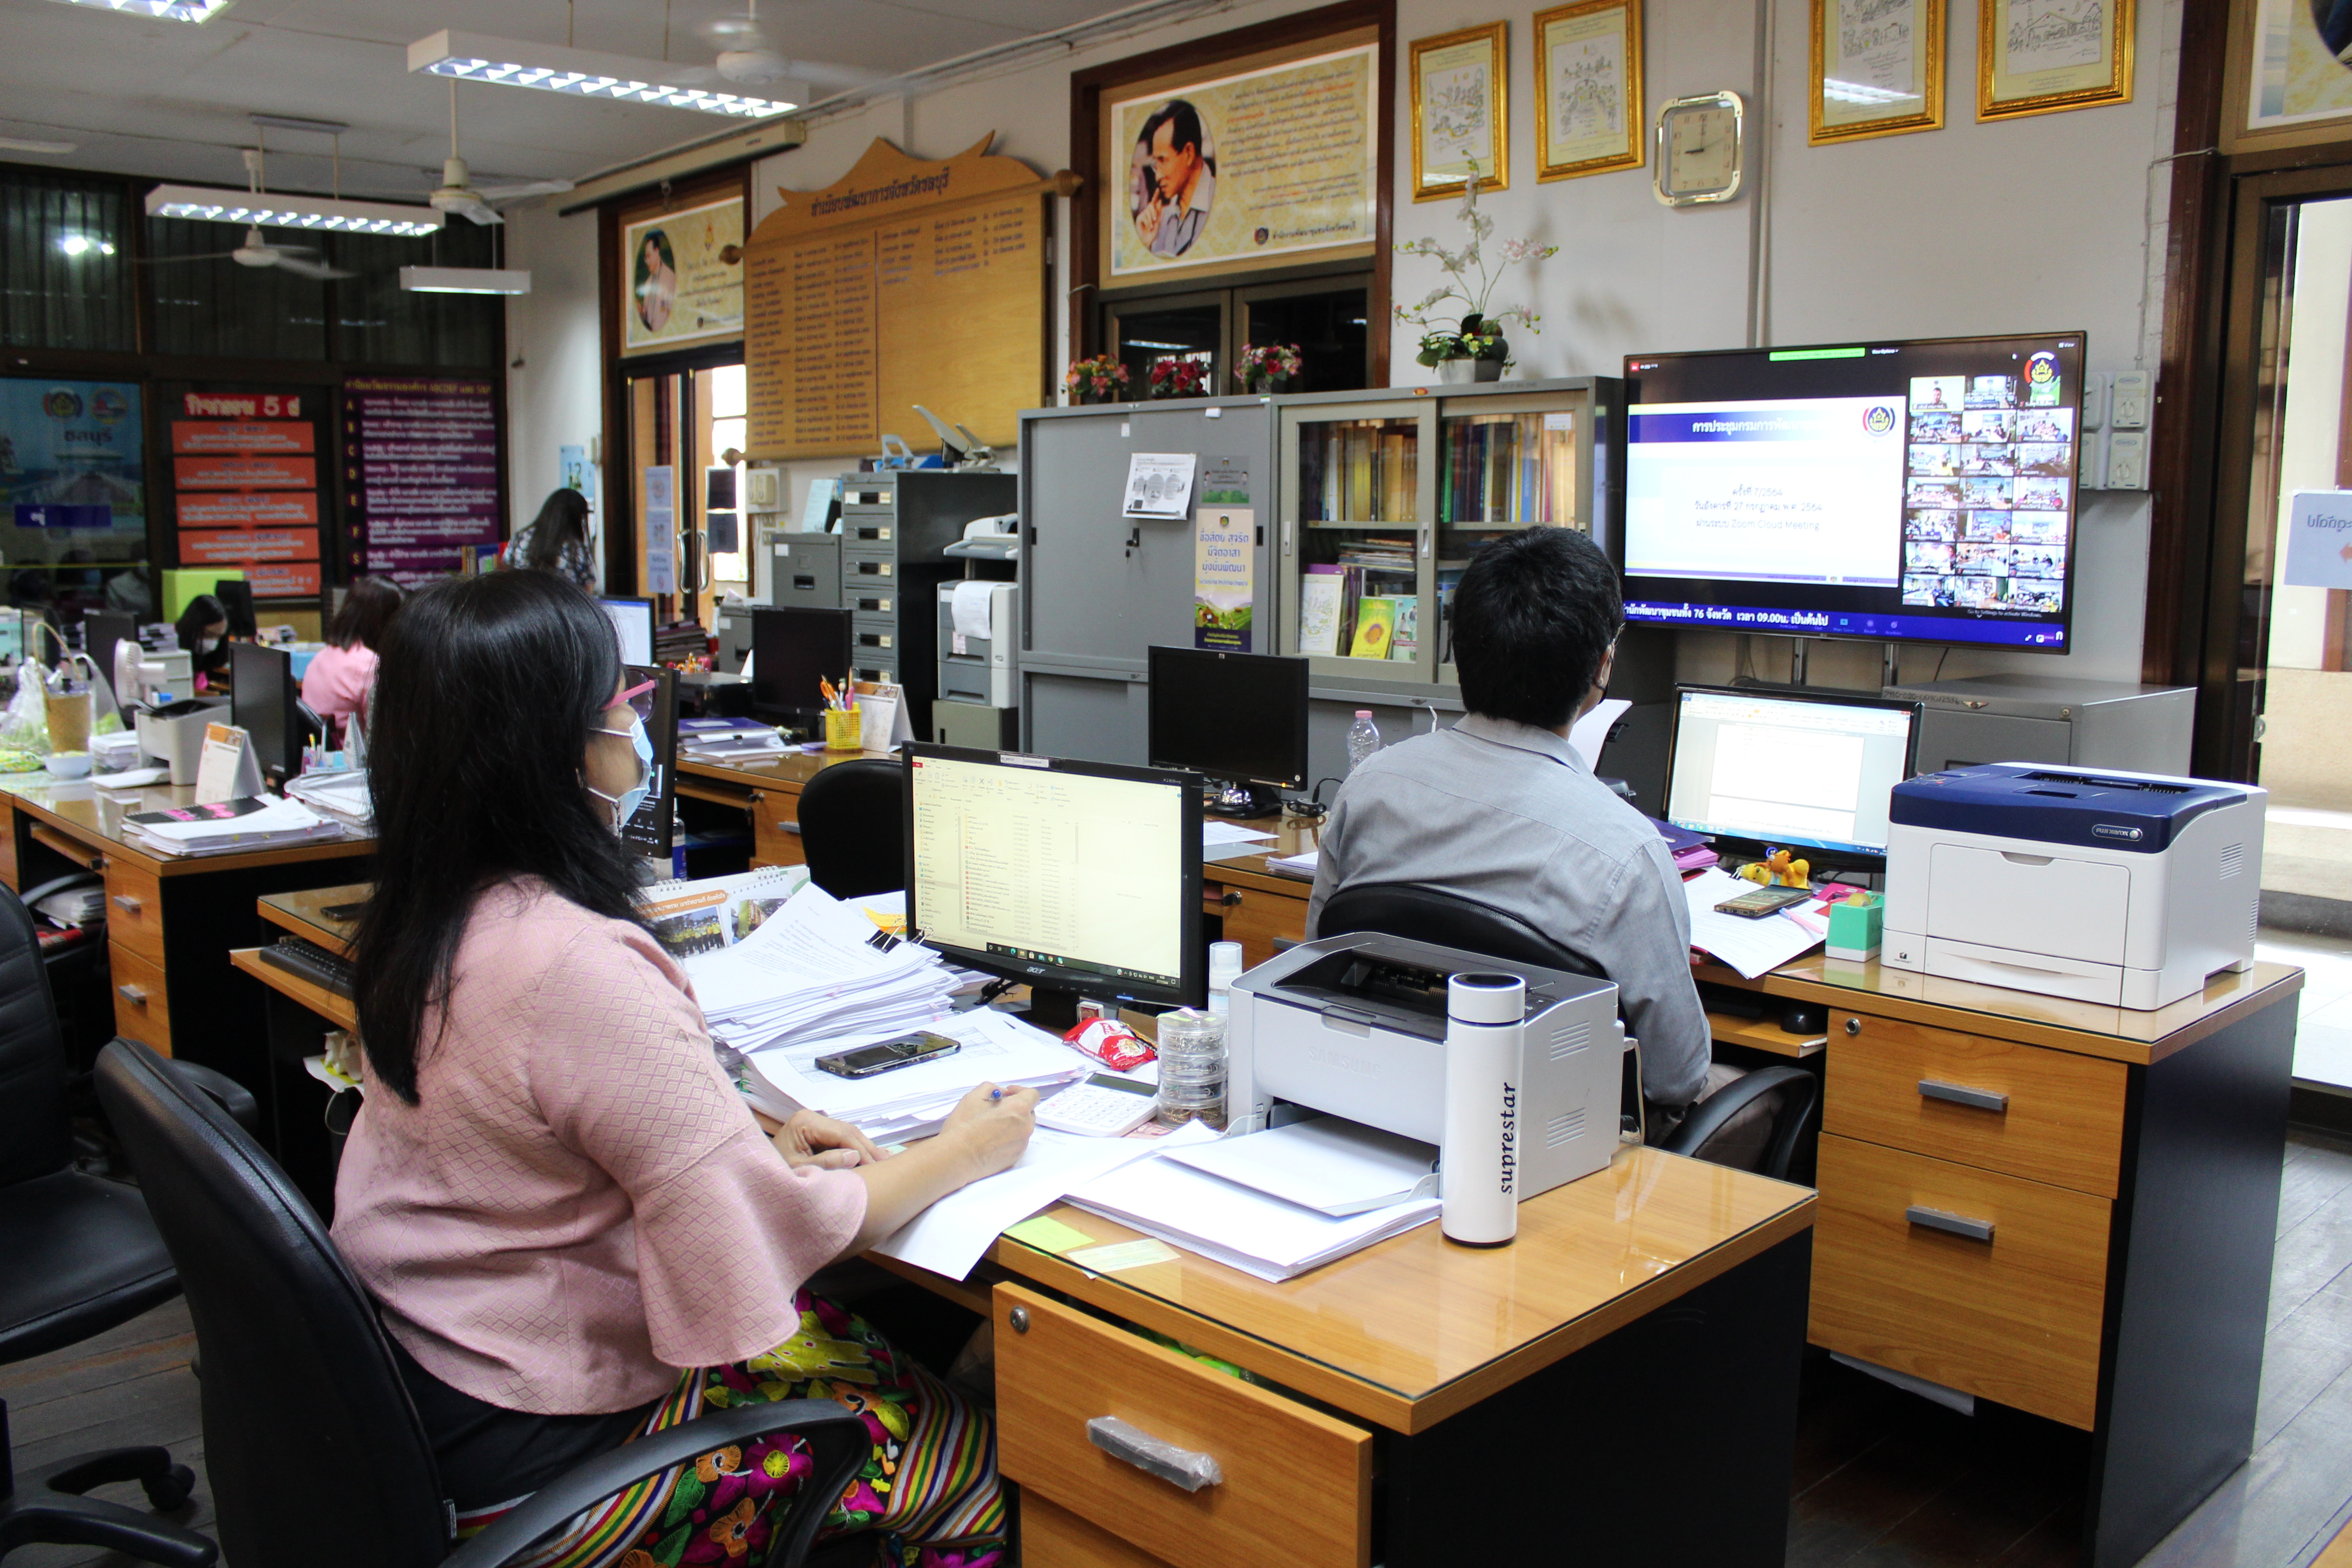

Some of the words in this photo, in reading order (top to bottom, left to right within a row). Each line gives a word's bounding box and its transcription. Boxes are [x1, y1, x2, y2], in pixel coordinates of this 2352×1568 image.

[264, 397, 279, 416] 5
[1732, 484, 1752, 496] ครั้งที่
[1754, 488, 1783, 498] 7/2564
[1694, 499, 1731, 510] วันอังคารที่
[1734, 502, 1743, 511] 27
[1801, 503, 1823, 512] 2564
[1731, 519, 1755, 528] Zoom
[1758, 520, 1783, 529] Cloud
[1785, 520, 1820, 532] Meeting
[1200, 528, 1225, 542] ซื่อสัตย์
[1228, 531, 1249, 545] สุจริต
[1208, 545, 1240, 557] มีจิตอาสา
[1202, 558, 1245, 574] มุ่งมั่นพัฒนา
[1622, 602, 1692, 621] ำนักพัฒนาชุมชนทั้ง
[1693, 609, 1705, 619] 76
[1705, 607, 1732, 621] จังหวัด
[1736, 612, 1755, 622] เวลา
[1790, 612, 1829, 627] เป็นต้นไป
[1027, 966, 1045, 975] acer
[1308, 1046, 1381, 1079] SAMSUNG
[1501, 1082, 1517, 1194] suprestar
